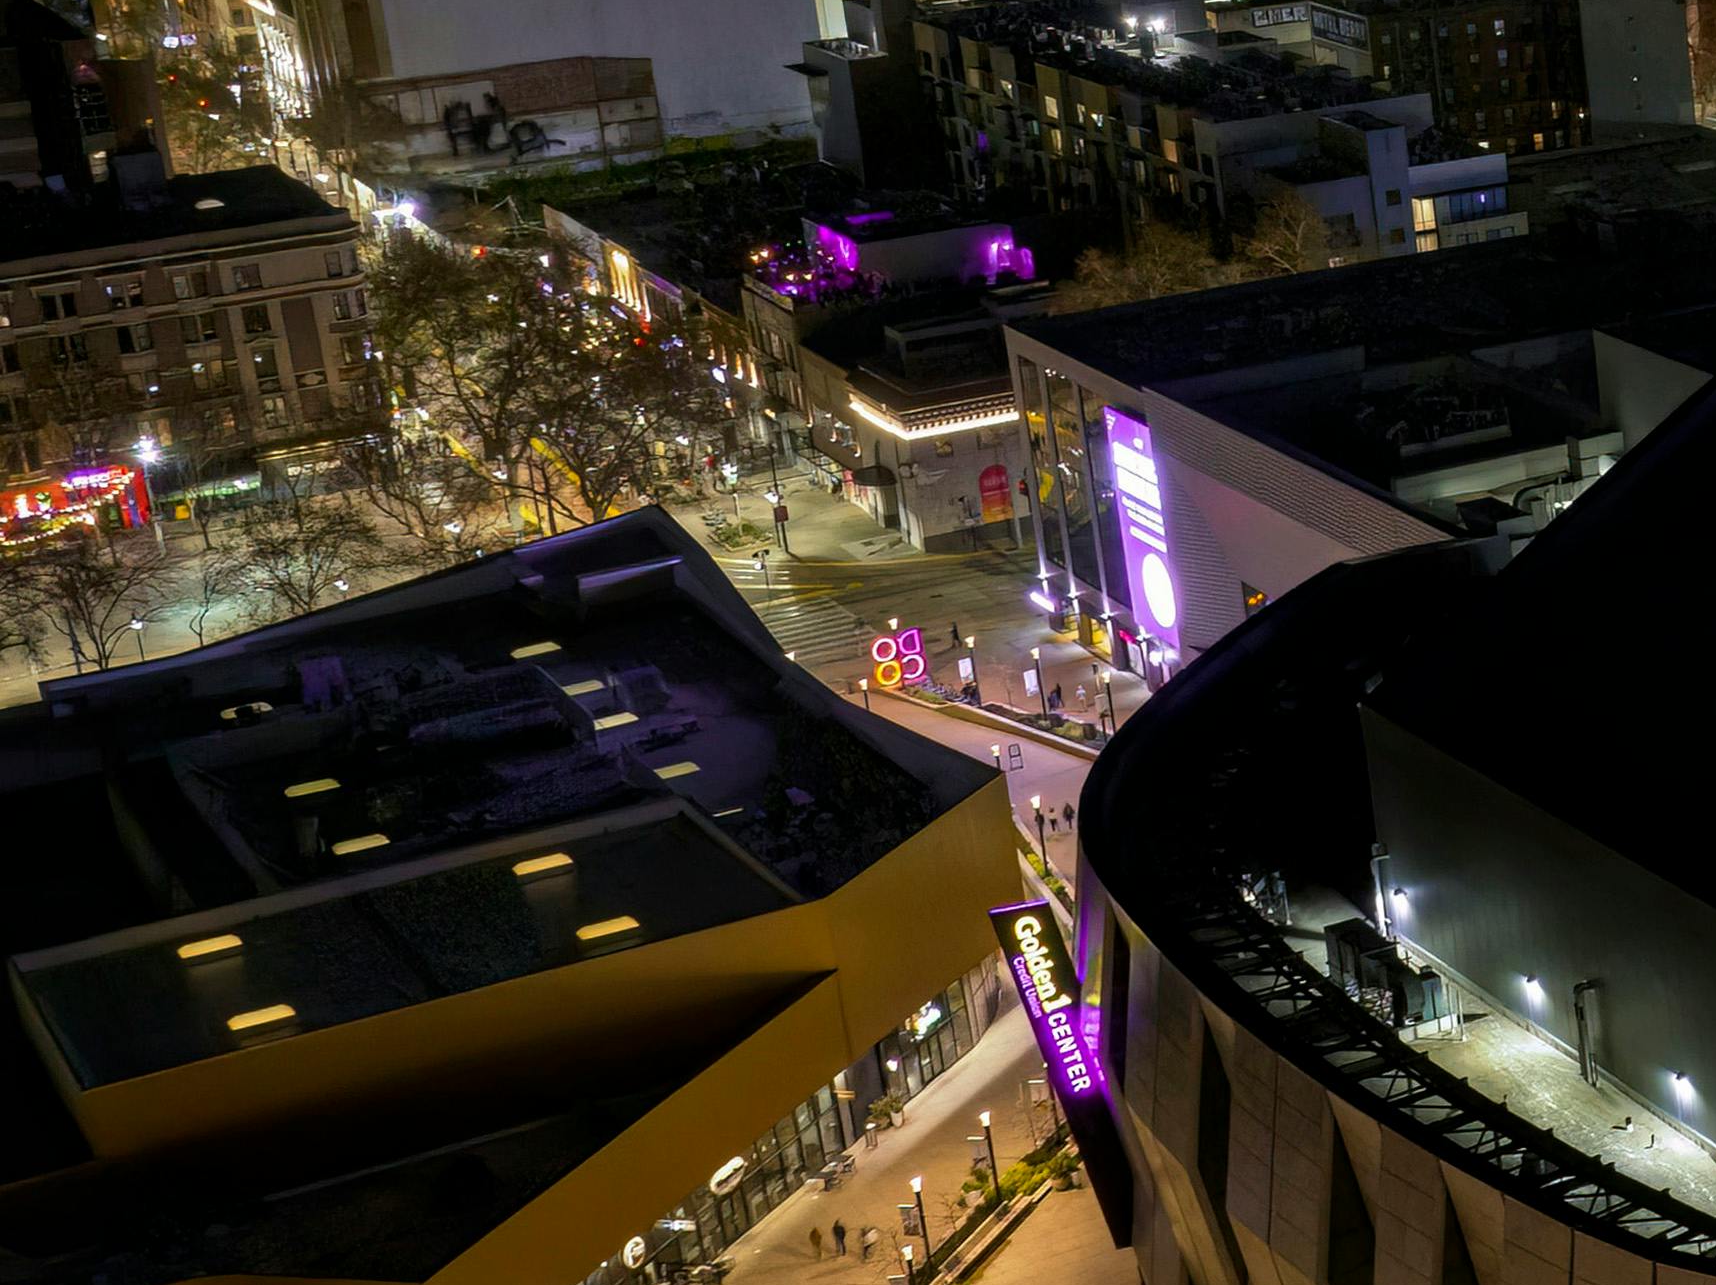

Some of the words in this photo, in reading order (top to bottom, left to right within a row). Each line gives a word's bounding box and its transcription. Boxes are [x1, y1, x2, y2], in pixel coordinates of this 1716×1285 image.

[1013, 956, 1030, 988] Credit
[1025, 988, 1042, 1018] Union
[1049, 1013, 1090, 1091] CENTER
